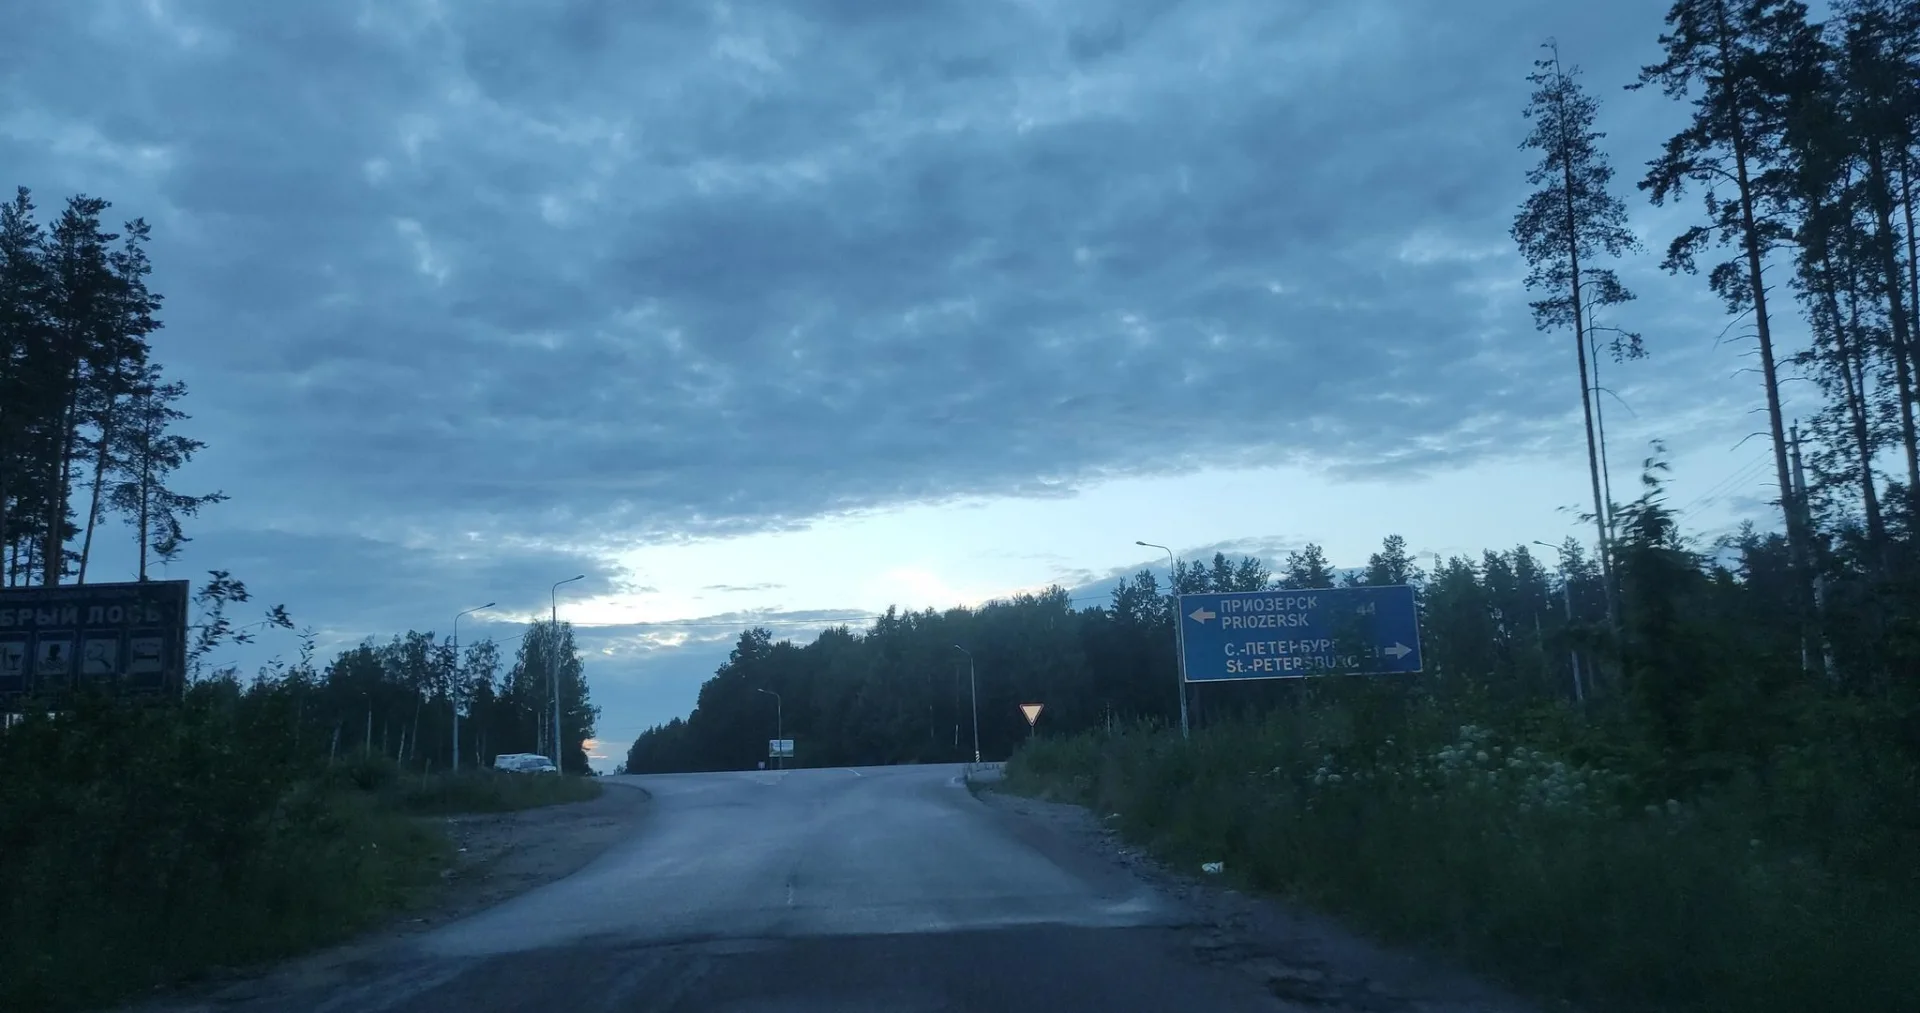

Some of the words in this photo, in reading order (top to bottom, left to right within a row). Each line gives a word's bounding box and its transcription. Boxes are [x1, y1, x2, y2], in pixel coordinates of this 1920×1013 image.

[1220, 596, 1318, 613] ПРИОЗЕРСК
[87, 605, 161, 625] ЛОСЬ
[1221, 613, 1309, 630] PRIOZERSK
